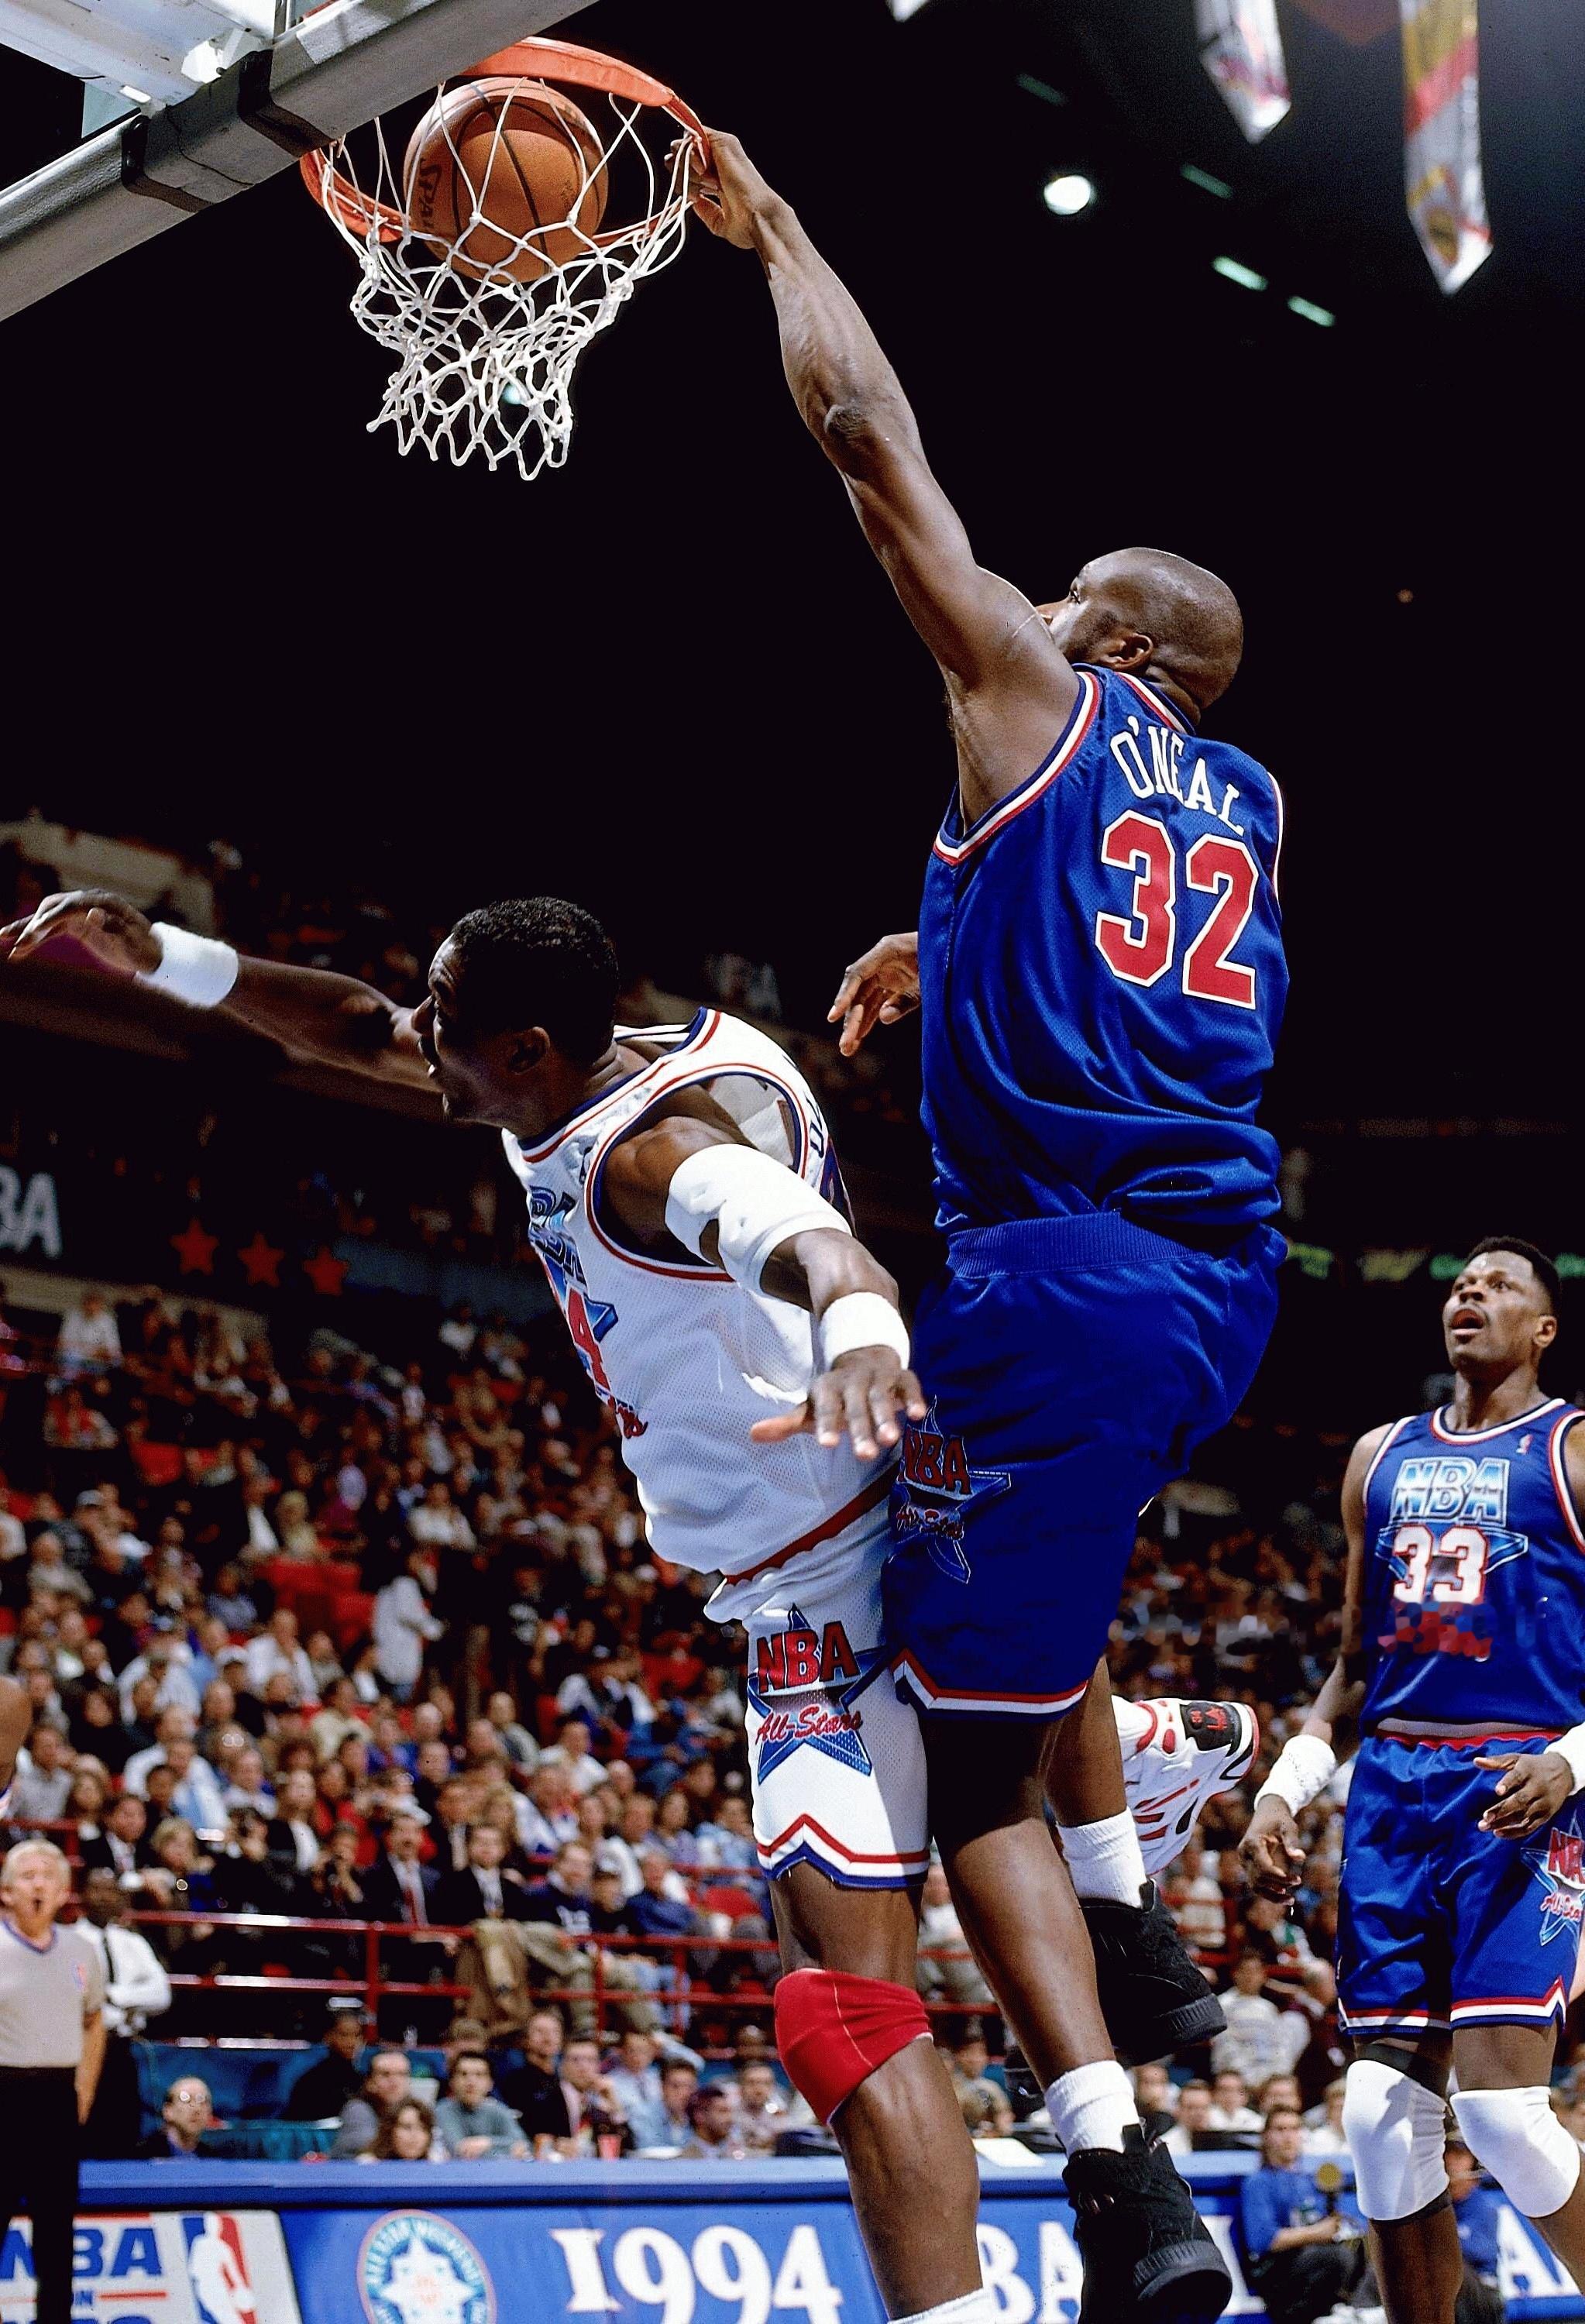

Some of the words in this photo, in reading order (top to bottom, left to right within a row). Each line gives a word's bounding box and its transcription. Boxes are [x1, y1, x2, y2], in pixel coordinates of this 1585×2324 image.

[1110, 716, 1244, 837] O'NEAL
[1095, 809, 1260, 1011] 32
[566, 1285, 611, 1393] 4
[897, 1425, 973, 1497] NBA
[1390, 1456, 1511, 1528] NBA
[1392, 1524, 1489, 1605] 33
[756, 1621, 861, 1694] NBA
[755, 1703, 863, 1745] All-Stars
[548, 2224, 843, 2324] 1994
[975, 2220, 1085, 2324] BA
